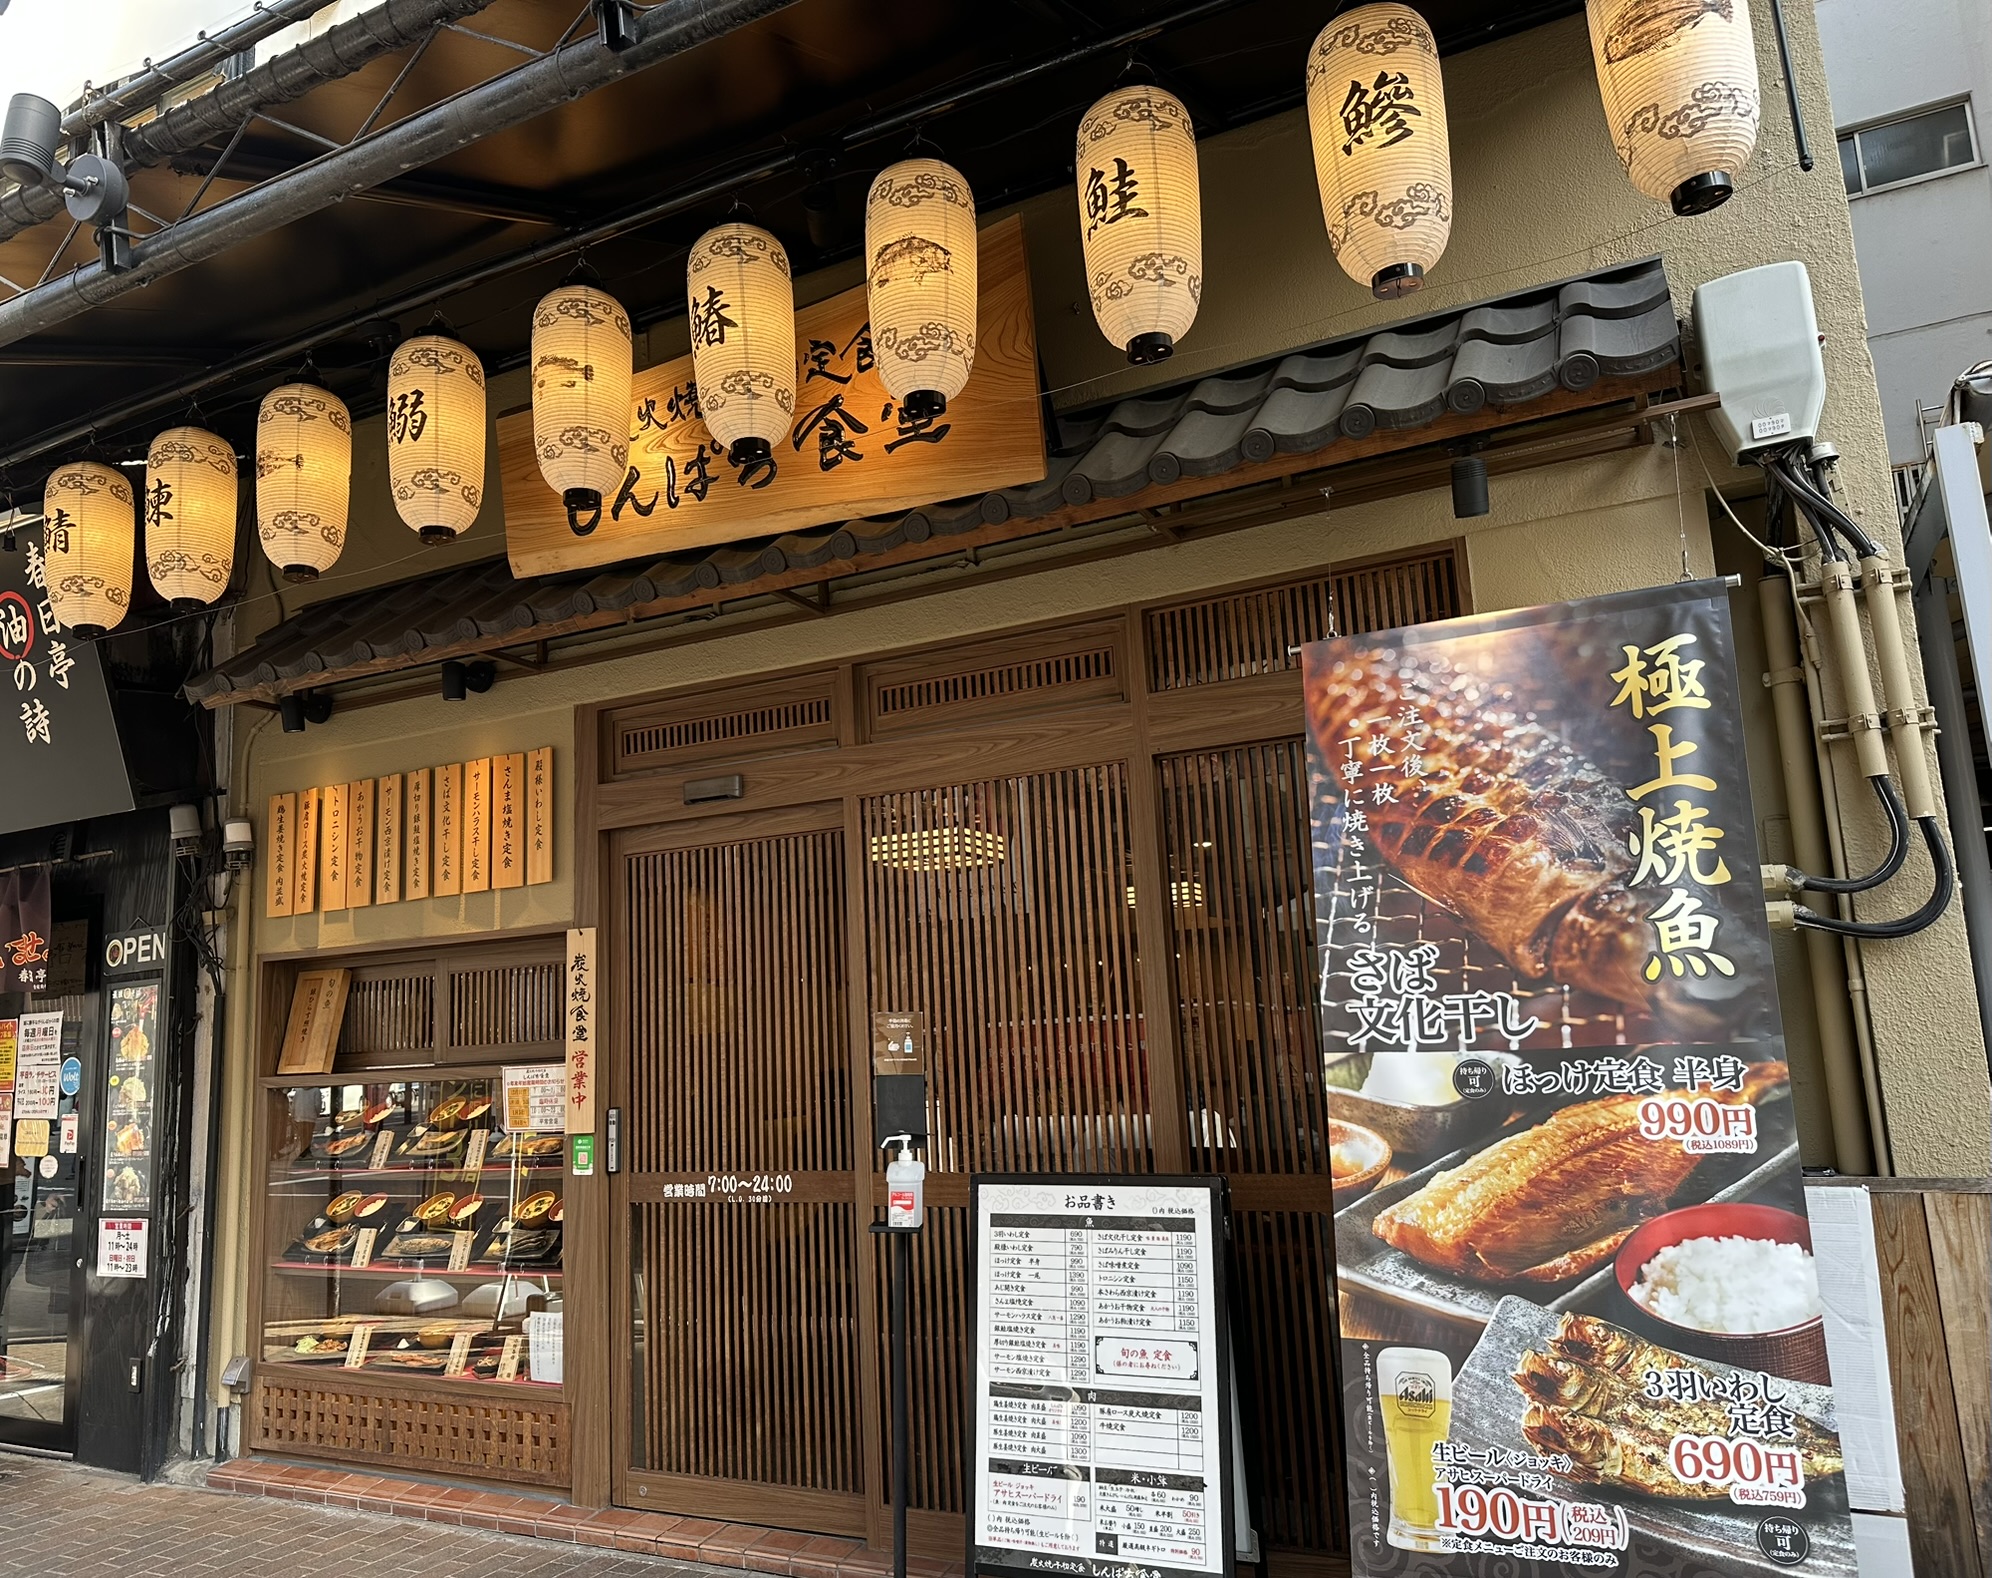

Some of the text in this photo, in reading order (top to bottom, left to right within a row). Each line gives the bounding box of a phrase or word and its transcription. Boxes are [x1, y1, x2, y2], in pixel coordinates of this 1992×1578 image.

[1085, 157, 1148, 242] 鮭
[691, 285, 738, 360] 鰆
[389, 388, 428, 445] 鰯
[1366, 714, 1399, 806] 一枚一枚
[535, 760, 543, 851] 殿様いわし定食
[1609, 632, 1736, 983] 極上焼魚
[502, 766, 513, 869] さんま塩焼き定食
[442, 776, 450, 881] さば文化干し定食
[471, 771, 481, 881] サーモンハラス干し定食
[330, 797, 340, 882] トロニシン定食
[354, 791, 365, 888] あかうお干物定食
[383, 785, 393, 893] サーモン西京漬け定食
[1338, 736, 1375, 934] 丁寧に焼き上げる
[105, 932, 165, 968] OPEN
[1346, 943, 1441, 995] さば
[1346, 991, 1538, 1046] 文化干し
[570, 952, 591, 1111] 炭火焼食堂 営業中
[63, 1071, 80, 1083] Wolt
[1459, 1064, 1487, 1075] 持ち帰り
[1502, 1055, 1749, 1096] ほっけ定食 半身
[1468, 1075, 1480, 1087] 可
[1639, 1100, 1752, 1138] 990円
[1685, 1137, 1756, 1151] (税込1089円)
[663, 1174, 793, 1198] 営業時間 7:00~24:00
[1064, 1193, 1116, 1211] お品書き
[1069, 1230, 1083, 1238] 690
[1097, 1233, 1143, 1241] さば文化干し定食
[1069, 1271, 1085, 1279] 1390
[1098, 1275, 1136, 1284] トロニシン定食
[1177, 1290, 1195, 1298] 1190
[1069, 1299, 1086, 1307] 1090
[1098, 1303, 1195, 1312] あかうお干物定食 1190
[994, 1311, 1042, 1321] サーモンハラス定食
[1069, 1313, 1086, 1321] 1290
[1178, 1319, 1195, 1327] 1150
[1070, 1341, 1086, 1349] 1190
[994, 1353, 1087, 1363] サーモン塩焼き定食 1290
[1120, 1347, 1173, 1362] 旬の魚 定食
[1070, 1369, 1087, 1377] 1290
[1645, 1370, 1788, 1402] 3羽いわし
[1087, 1390, 1097, 1402] 肉
[1399, 1386, 1433, 1403] Asahi
[1070, 1418, 1087, 1426] 1200
[1180, 1412, 1199, 1420] 1200
[1727, 1403, 1797, 1438] 定食
[1070, 1433, 1087, 1441] 1090
[1181, 1427, 1199, 1435] 1200
[1070, 1447, 1087, 1455] 1300
[1672, 1438, 1802, 1487] 690円
[993, 1480, 1013, 1488] 生ビール
[1434, 1466, 1553, 1490] アサヒスーパードライ
[993, 1489, 1063, 1504] アサヒスーパードライ
[1189, 1494, 1199, 1502] 90
[1732, 1486, 1803, 1504] (税込759円)
[1437, 1486, 1556, 1541] 190円
[1134, 1522, 1145, 1530] 150
[1160, 1525, 1172, 1533] 200
[1188, 1528, 1201, 1536] 250
[1763, 1521, 1799, 1537] 持ち帰り
[1776, 1536, 1791, 1551] 可
[1191, 1548, 1201, 1556] 90
